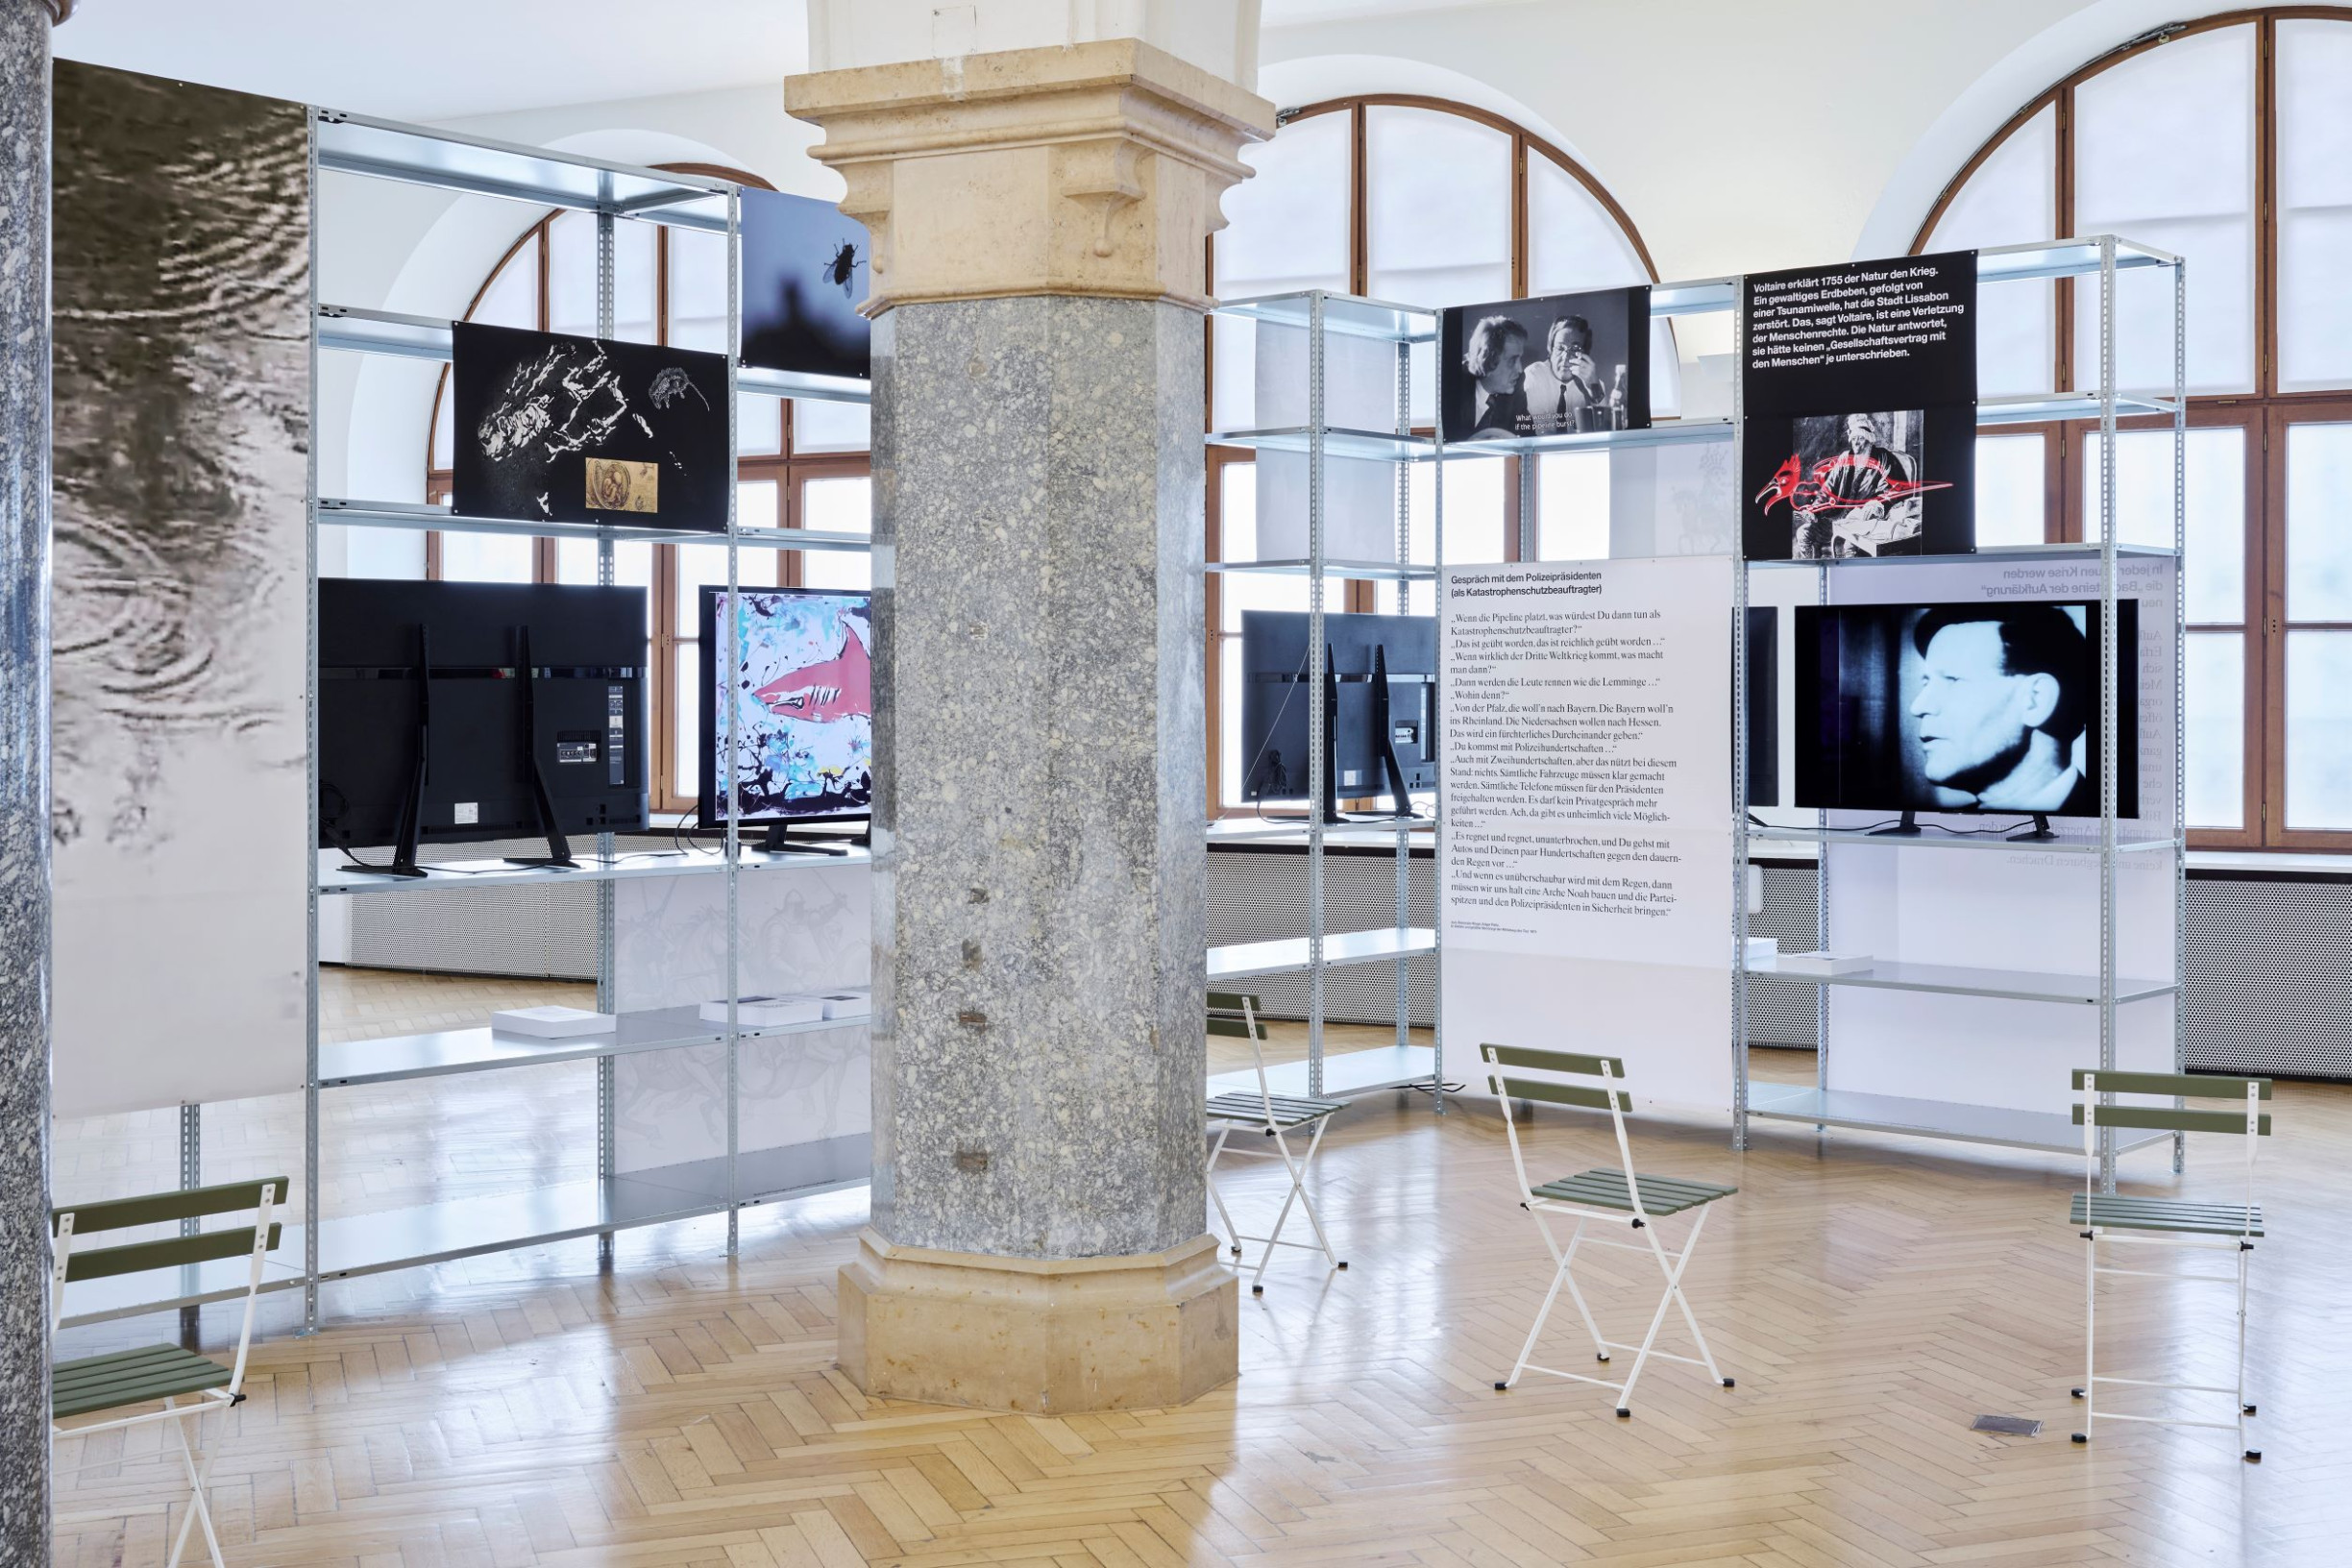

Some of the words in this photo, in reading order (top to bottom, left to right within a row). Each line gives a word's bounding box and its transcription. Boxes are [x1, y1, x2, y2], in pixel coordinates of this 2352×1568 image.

[1753, 281, 1786, 292] Voltaire
[1787, 277, 1820, 289] erklärt
[1821, 275, 1843, 286] 1755
[1844, 274, 1859, 284] der
[1861, 271, 1888, 282] Natur
[1890, 270, 1908, 280] den
[1910, 267, 1939, 279] Krieg.
[1753, 294, 1767, 305] Ein
[1769, 291, 1820, 306] gewaltiges
[1821, 286, 1868, 299] Erdbeben,
[1869, 282, 1904, 297] gefolgt
[1905, 282, 1923, 291] von
[1752, 307, 1776, 318] einer
[1776, 301, 1843, 316] Tsunamiwelle,
[1844, 299, 1859, 309] hat
[1860, 298, 1875, 308] die
[1876, 295, 1903, 306] Stadt
[1904, 292, 1948, 305] Lissabon
[1752, 318, 1791, 331] zerstört.
[1792, 317, 1814, 327] Das,
[1815, 314, 1836, 327] sagt
[1837, 311, 1874, 324] Voltaire,
[1875, 309, 1889, 320] ist
[1890, 308, 1911, 319] eine
[1912, 305, 1964, 317] Verletzung
[1752, 332, 1768, 343] der
[1769, 327, 1850, 342] Menschenrechte.
[1850, 325, 1867, 335] Die
[1868, 323, 1896, 334] Natur
[1897, 318, 1947, 331] antwortet,
[1752, 345, 1766, 355] sie
[1767, 343, 1792, 355] hätte
[1793, 341, 1825, 353] keinen
[1929, 331, 1946, 342] mit
[1752, 358, 1770, 369] den
[1825, 355, 1834, 365] je
[1835, 348, 1910, 362] unterschrieben.
[1556, 419, 1575, 428] burst?
[1451, 574, 1490, 586] Gespräch
[1491, 573, 1505, 582] mit
[1506, 573, 1524, 582] dem
[1526, 571, 1602, 583] Polizeipräsidenten
[1451, 587, 1465, 599] (als
[1466, 583, 1603, 598] Katastrophenschutzbeauftragter)
[1479, 612, 1490, 622] die
[1492, 611, 1523, 625] Pipeline
[1564, 610, 1595, 621] würdest
[1597, 609, 1610, 620] Du
[1611, 609, 1631, 620] dann
[1633, 609, 1648, 619] tun
[1649, 608, 1660, 619] als
[1471, 638, 1480, 648] ist
[1481, 637, 1503, 650] geübt
[1536, 637, 1549, 647] das
[1550, 637, 1558, 647] ist
[1560, 636, 1594, 647] reichlich
[1595, 636, 1618, 649] geübt
[1620, 635, 1652, 646] worden
[1479, 650, 1508, 660] wirklich
[1509, 650, 1523, 660] der
[1525, 649, 1548, 660] Dritte
[1549, 649, 1587, 662] Weltkrieg
[1637, 649, 1663, 659] macht
[1477, 676, 1506, 686] werden
[1507, 676, 1519, 686] die
[1520, 676, 1543, 686] Leute
[1573, 676, 1587, 686] wie
[1588, 676, 1601, 686] die
[1603, 676, 1646, 689] Lemminge
[1471, 702, 1484, 712] der
[1507, 702, 1520, 712] die
[1546, 702, 1565, 713] nach
[1599, 702, 1614, 713] Die
[1615, 702, 1646, 716] Bayern
[1450, 715, 1460, 724] ins
[1506, 715, 1520, 725] Die
[1521, 716, 1578, 726] Niedersachsen
[1579, 716, 1605, 726] wollen
[1607, 717, 1627, 726] nach
[1450, 727, 1465, 738] Das
[1466, 727, 1483, 738] wird
[1485, 728, 1497, 738] ein
[1498, 728, 1551, 739] fürchterliches
[1552, 728, 1611, 740] Durcheinander
[1476, 754, 1489, 764] mit
[1576, 755, 1594, 766] aber
[1595, 756, 1609, 766] das
[1610, 756, 1631, 767] nützt
[1632, 756, 1646, 767] bei
[1647, 757, 1677, 768] diesem
[1450, 793, 1495, 805] freigehalten
[1528, 795, 1538, 804] Es
[1539, 795, 1556, 805] darf
[1556, 795, 1574, 805] kein
[1576, 796, 1634, 809] Privatgespräch
[1635, 797, 1657, 807] mehr
[1451, 894, 1477, 907] spitzen
[1479, 896, 1494, 907] und
[1495, 896, 1508, 907] den
[1510, 897, 1581, 912] Polizeipräsidenten
[1582, 901, 1590, 912] in
[1591, 902, 1632, 914] Sicherheit
